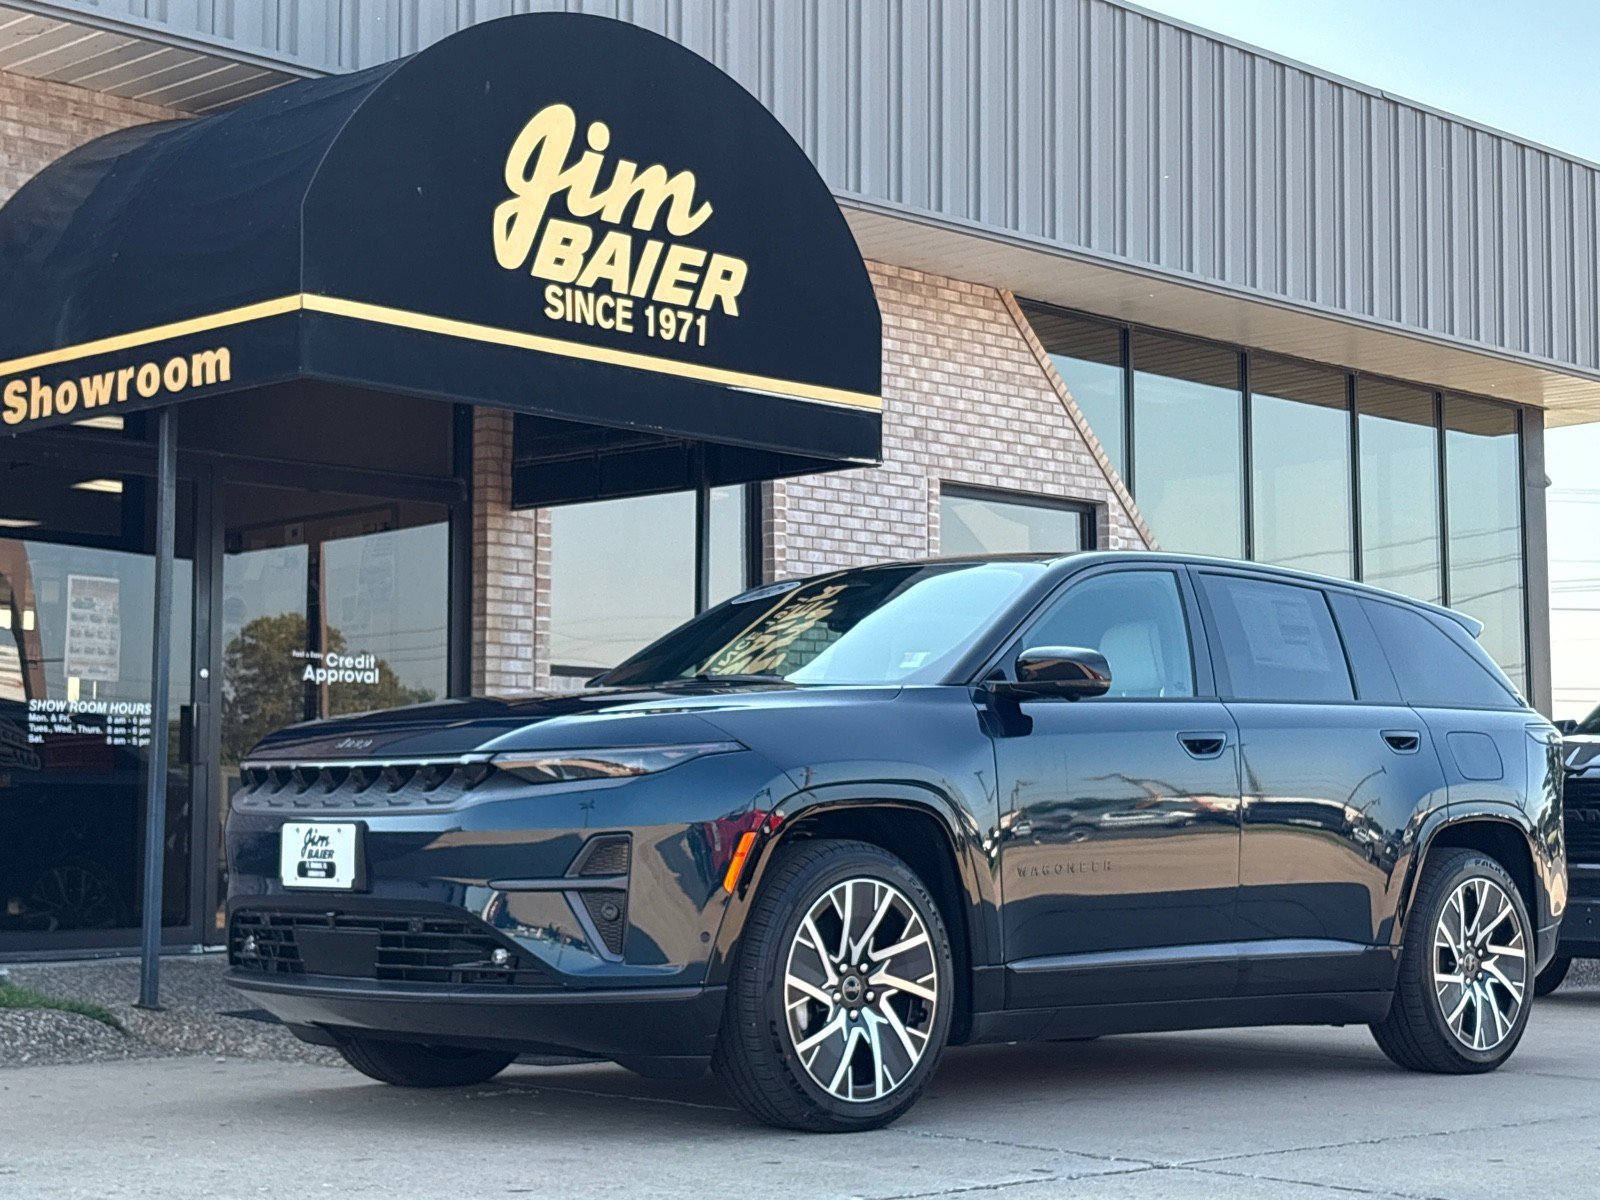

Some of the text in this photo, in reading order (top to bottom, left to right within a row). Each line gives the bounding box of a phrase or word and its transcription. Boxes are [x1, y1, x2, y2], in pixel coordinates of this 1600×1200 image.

[493, 104, 713, 270] Jim
[530, 218, 748, 317] BAIER
[543, 284, 708, 347] SINCE 1971
[2, 346, 231, 425] Showroom
[326, 653, 375, 669] Credit
[303, 664, 379, 685] Approval
[28, 699, 152, 716] SHOW ROOM HOURS
[301, 827, 330, 858] Jim
[307, 849, 335, 860] BAIER
[1016, 860, 1112, 878] WAGONEER
